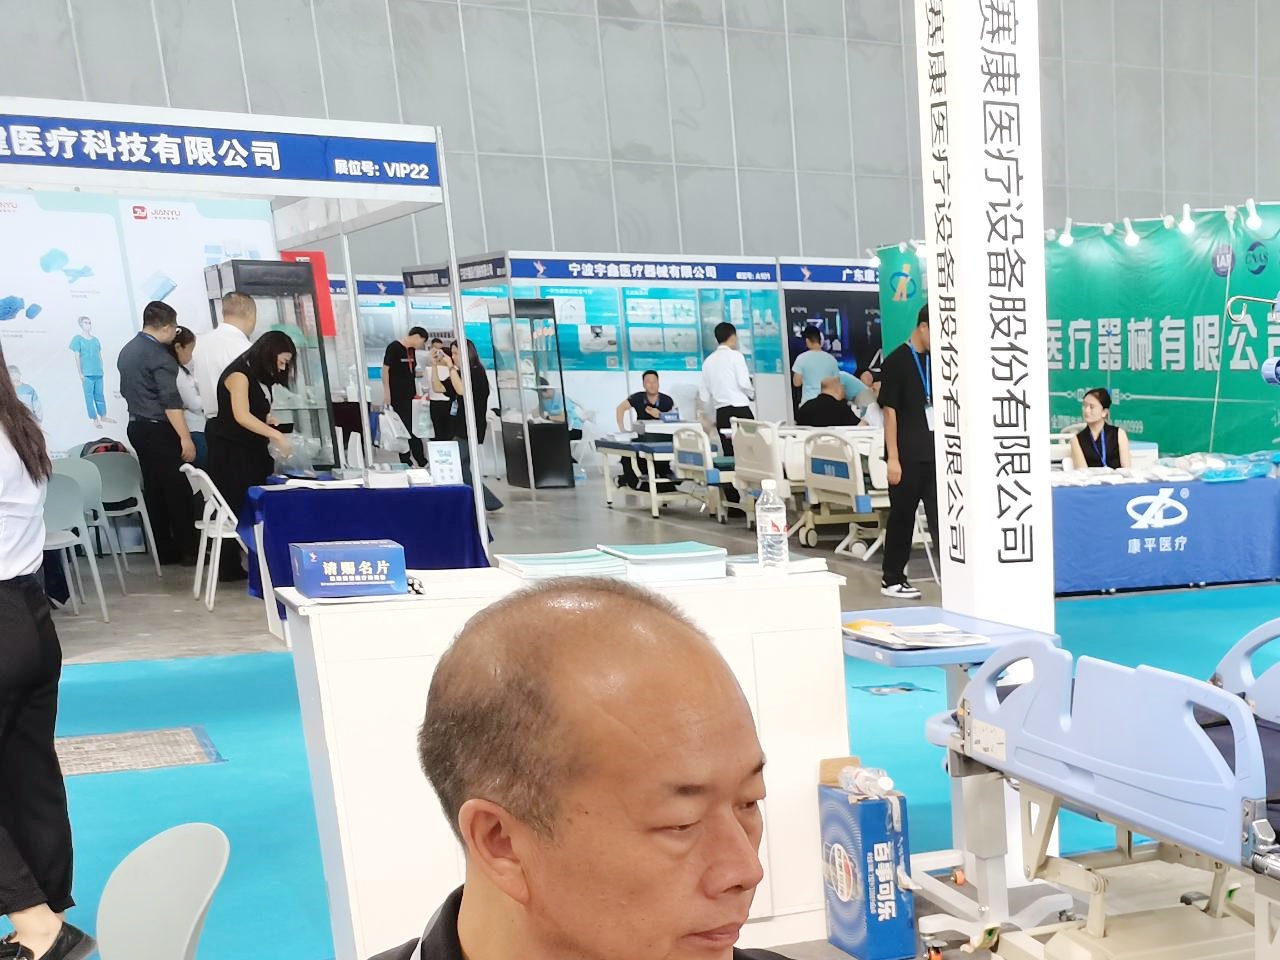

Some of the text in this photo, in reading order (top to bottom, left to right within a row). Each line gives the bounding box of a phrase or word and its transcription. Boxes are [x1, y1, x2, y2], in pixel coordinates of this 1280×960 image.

[385, 162, 429, 179] VIP22
[1128, 536, 1188, 554] 康平医疗
[873, 842, 897, 922] 百事可乐
